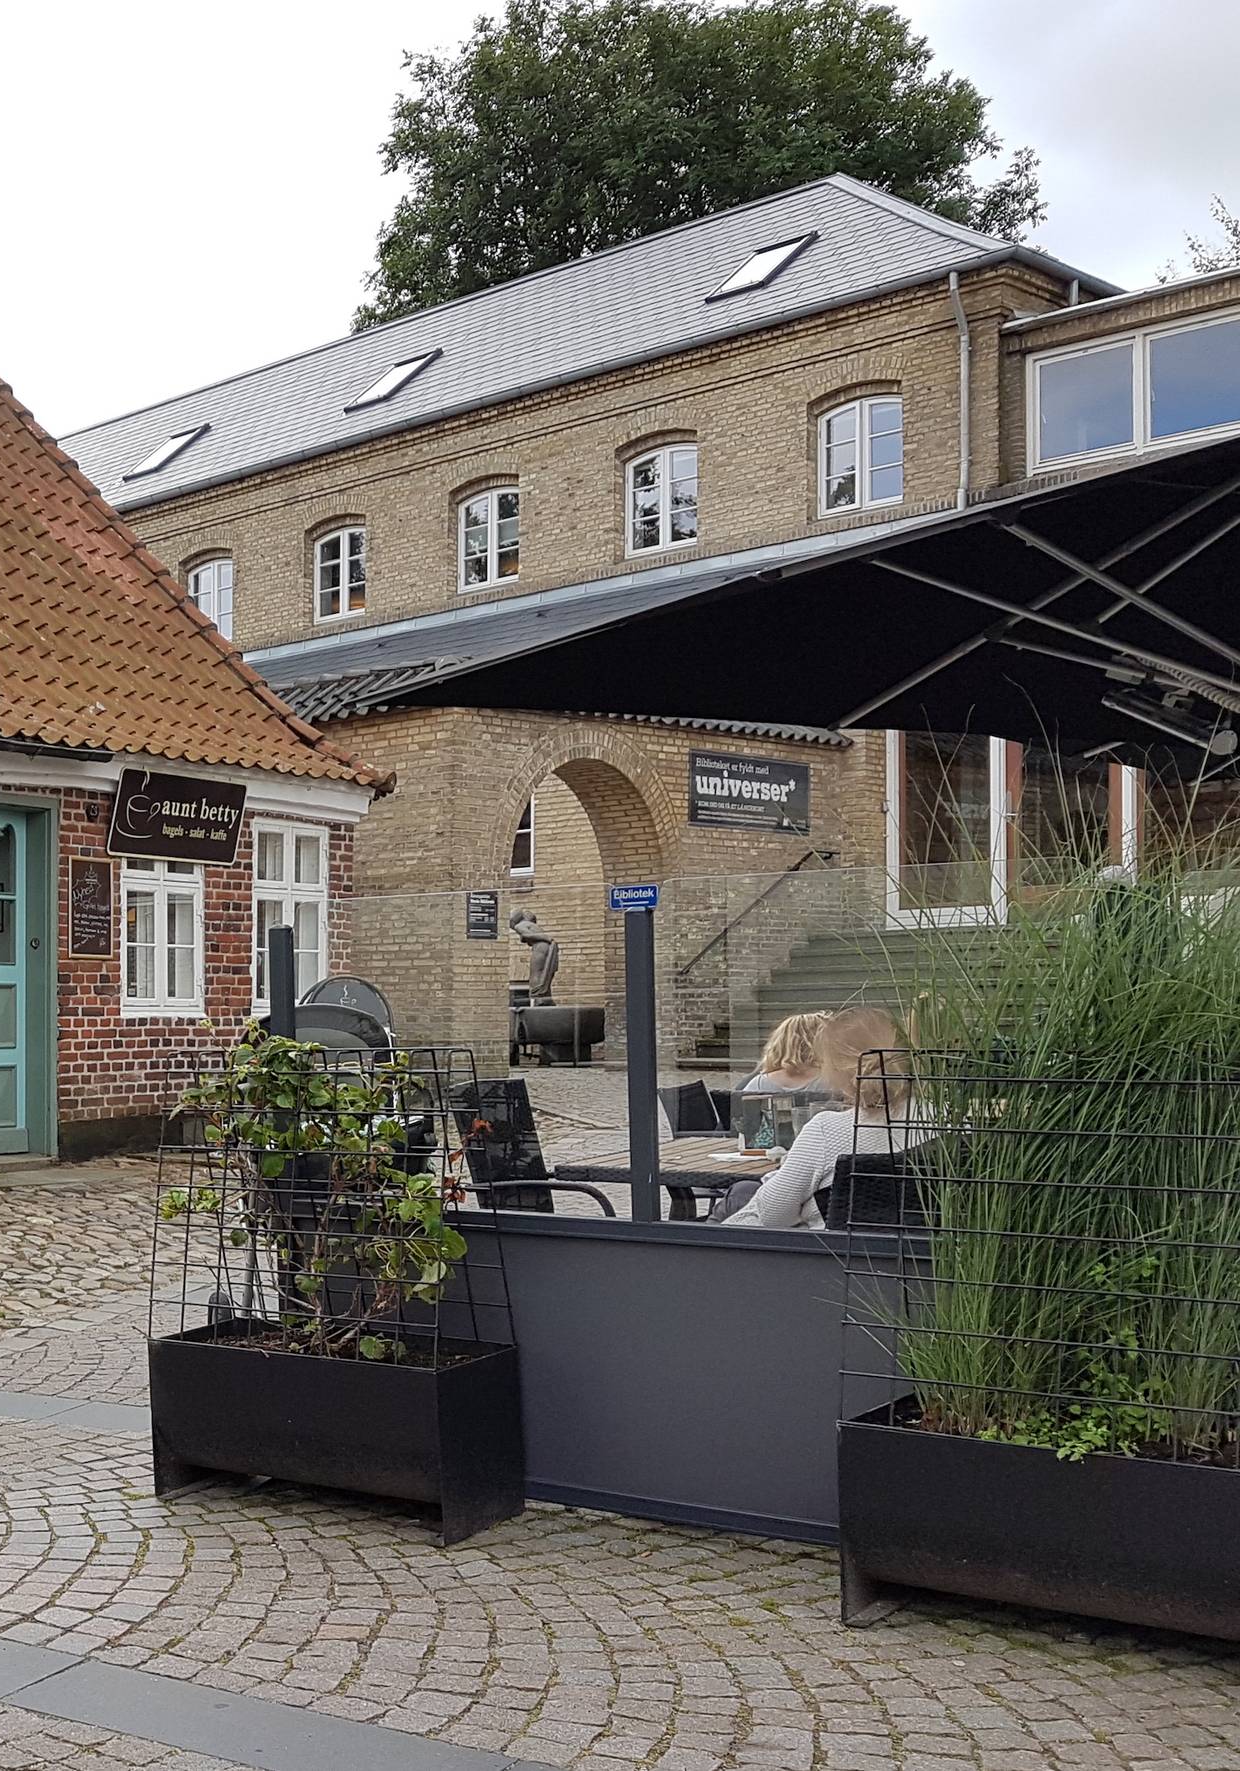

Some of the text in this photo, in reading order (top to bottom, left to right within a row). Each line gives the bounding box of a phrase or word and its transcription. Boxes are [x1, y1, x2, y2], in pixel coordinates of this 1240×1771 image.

[696, 757, 730, 770] Biblioteket
[739, 762, 754, 775] fyldt
[755, 766, 769, 775] med
[161, 797, 239, 829] aunt betty
[162, 822, 227, 841] bagels salat kaffe
[613, 888, 655, 899] Bibliotek
